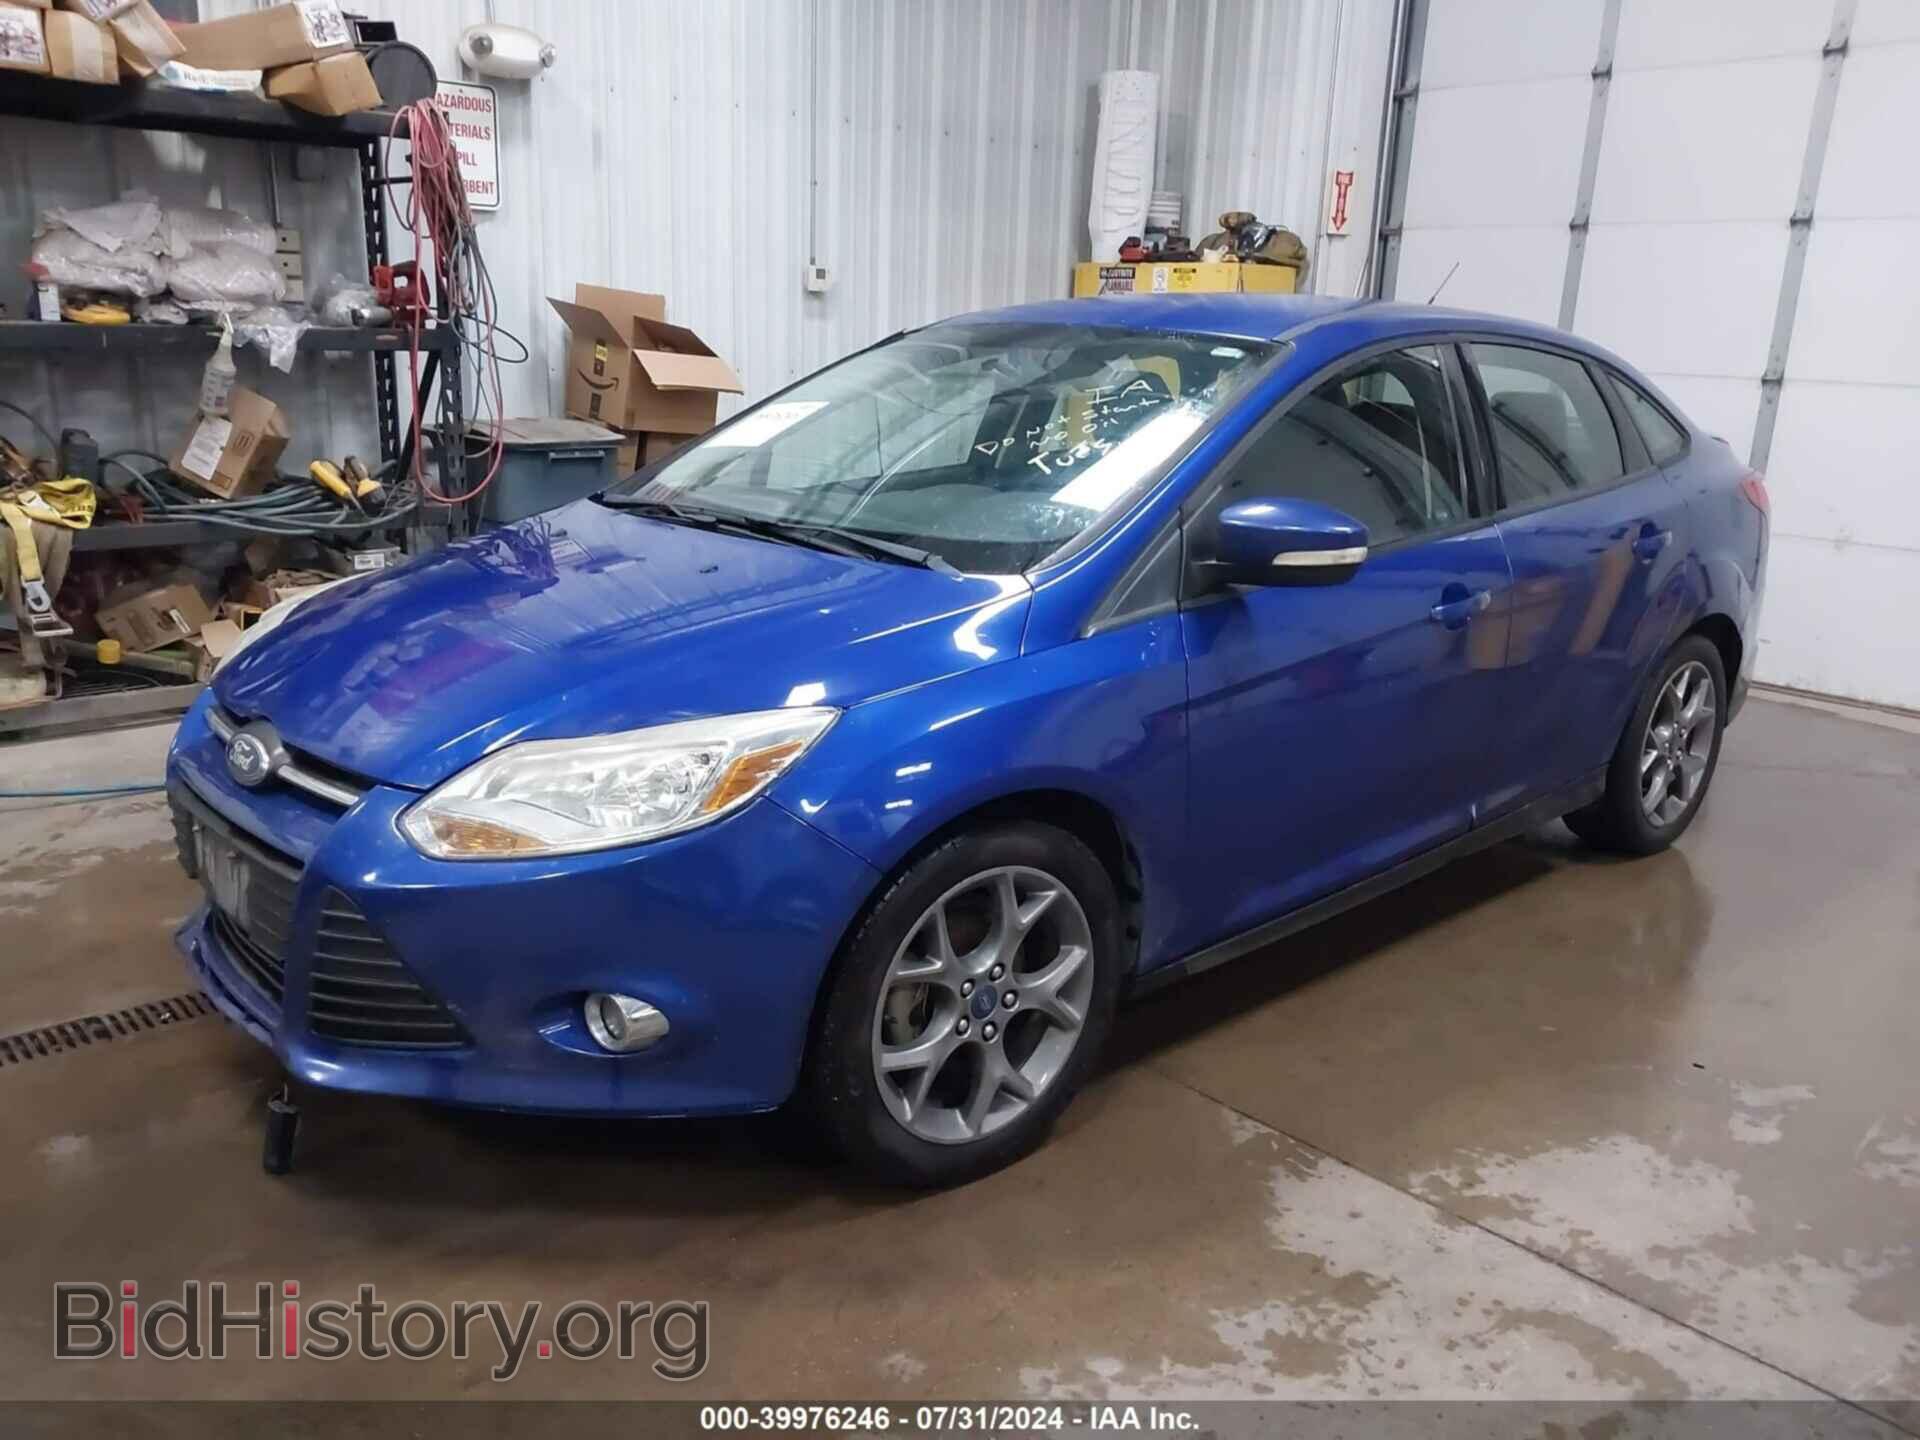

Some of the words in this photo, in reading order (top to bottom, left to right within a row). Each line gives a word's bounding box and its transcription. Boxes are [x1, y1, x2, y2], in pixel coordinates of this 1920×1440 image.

[437, 94, 491, 112] AZARDOUS
[450, 124, 491, 140] TERIALS
[456, 151, 478, 166] PILL
[464, 180, 494, 194] RBENT
[233, 741, 254, 770] Ford
